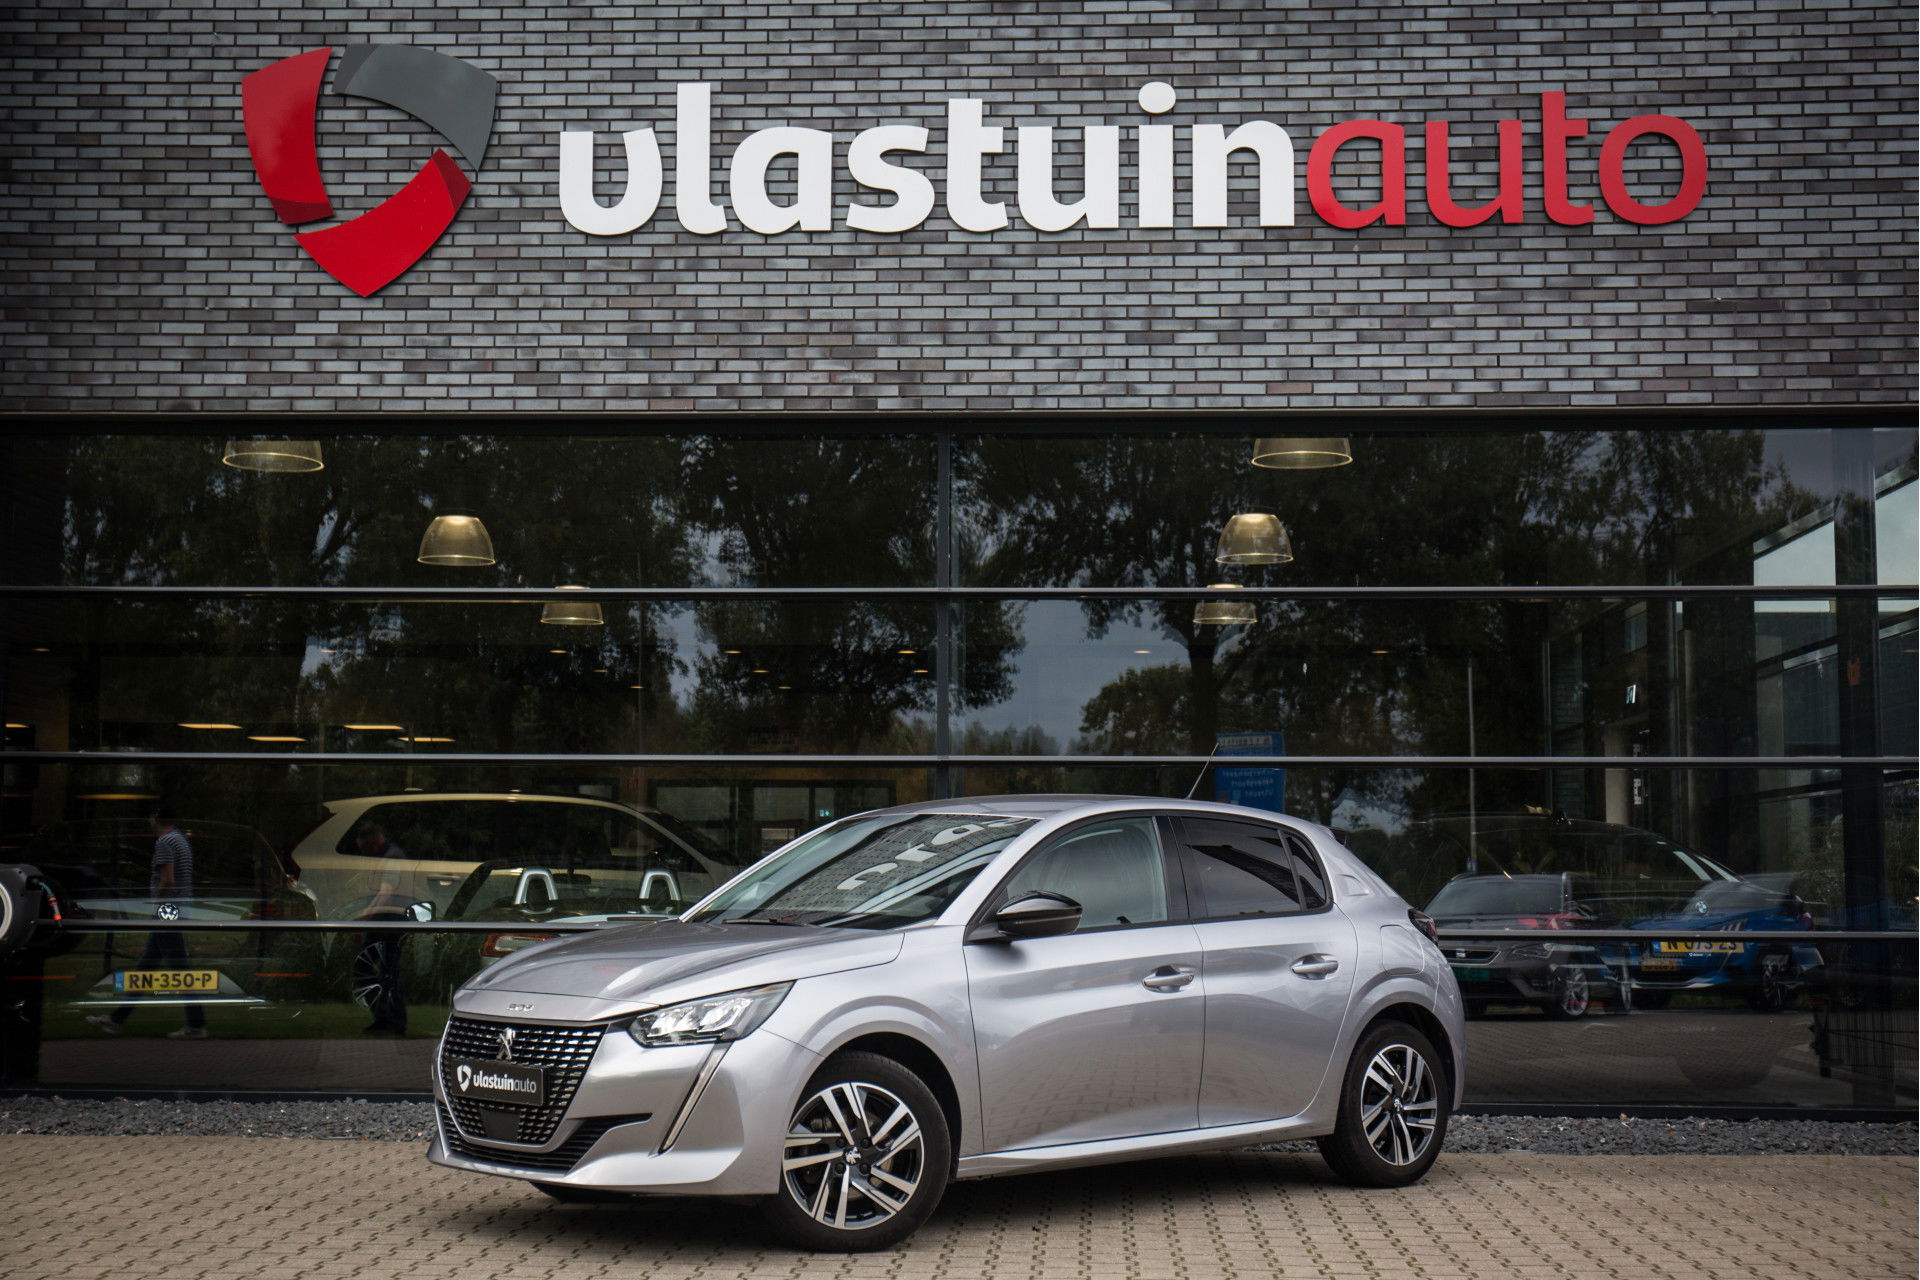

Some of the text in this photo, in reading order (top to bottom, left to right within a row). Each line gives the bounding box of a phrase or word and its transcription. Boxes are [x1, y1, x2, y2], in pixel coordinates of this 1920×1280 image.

[559, 81, 1708, 235] vlastuinauto
[128, 973, 212, 988] RN-350-P
[473, 1069, 537, 1093] vlastuinauto
